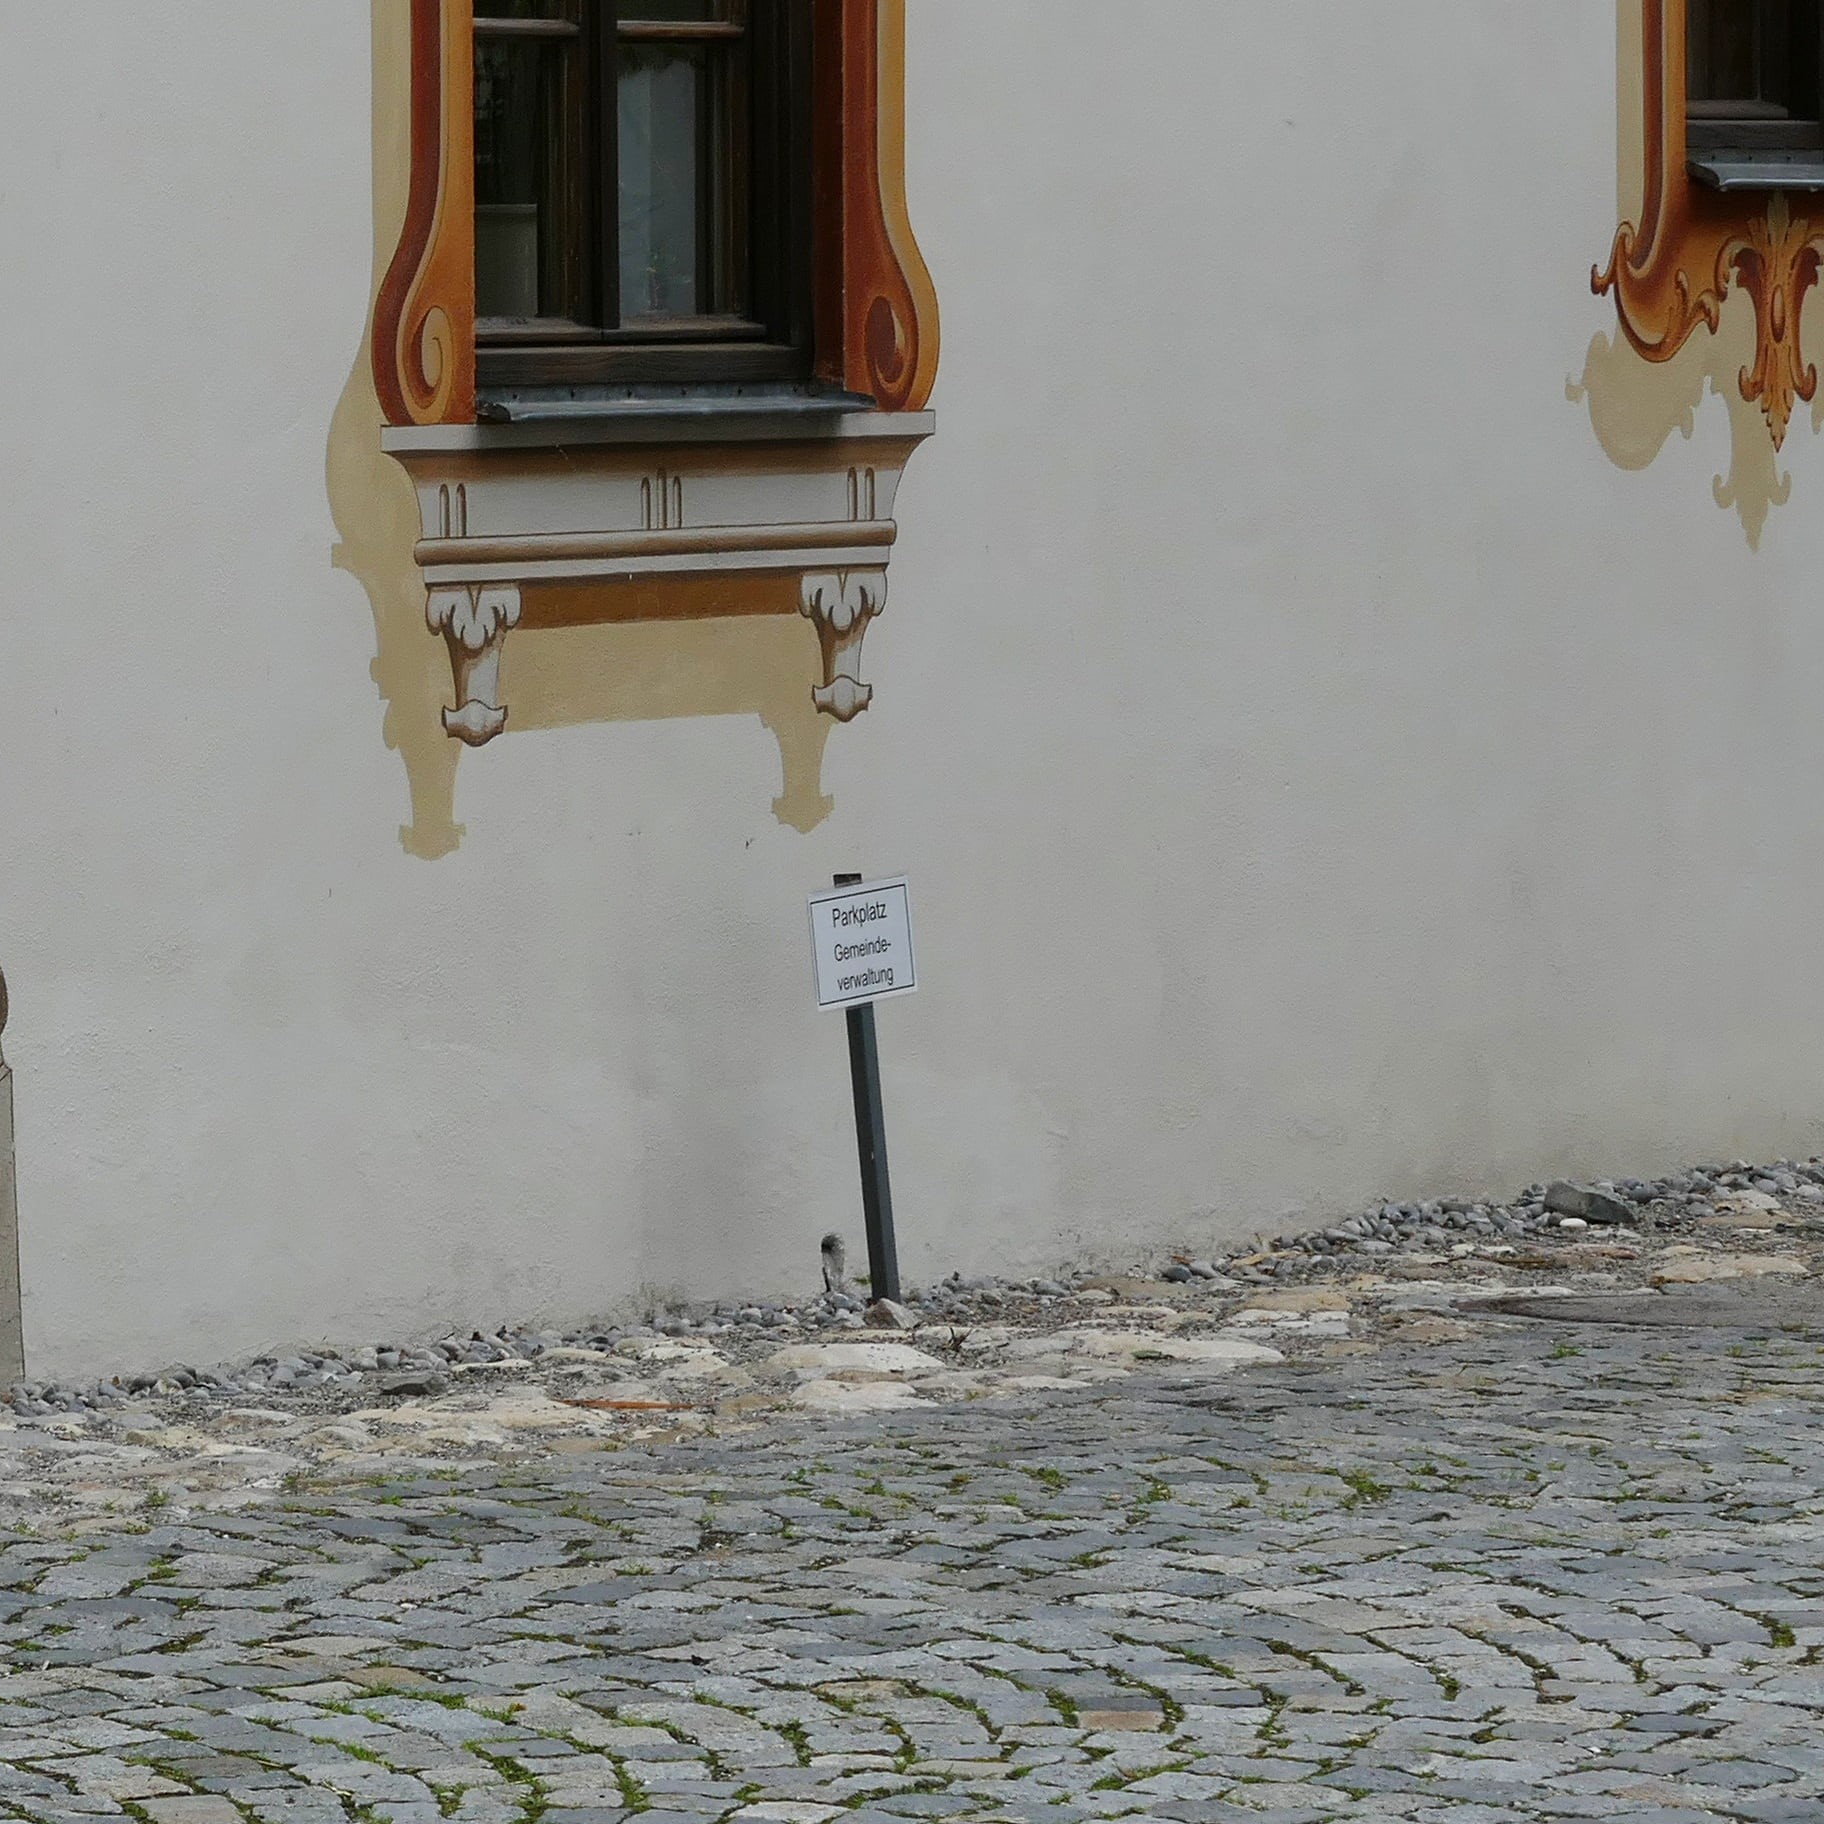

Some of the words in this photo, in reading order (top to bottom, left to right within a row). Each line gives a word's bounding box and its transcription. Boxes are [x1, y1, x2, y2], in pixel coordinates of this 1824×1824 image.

[832, 902, 887, 928] Parkplatz
[834, 936, 892, 962] Gemeinde-
[837, 967, 894, 991] verwaltung
